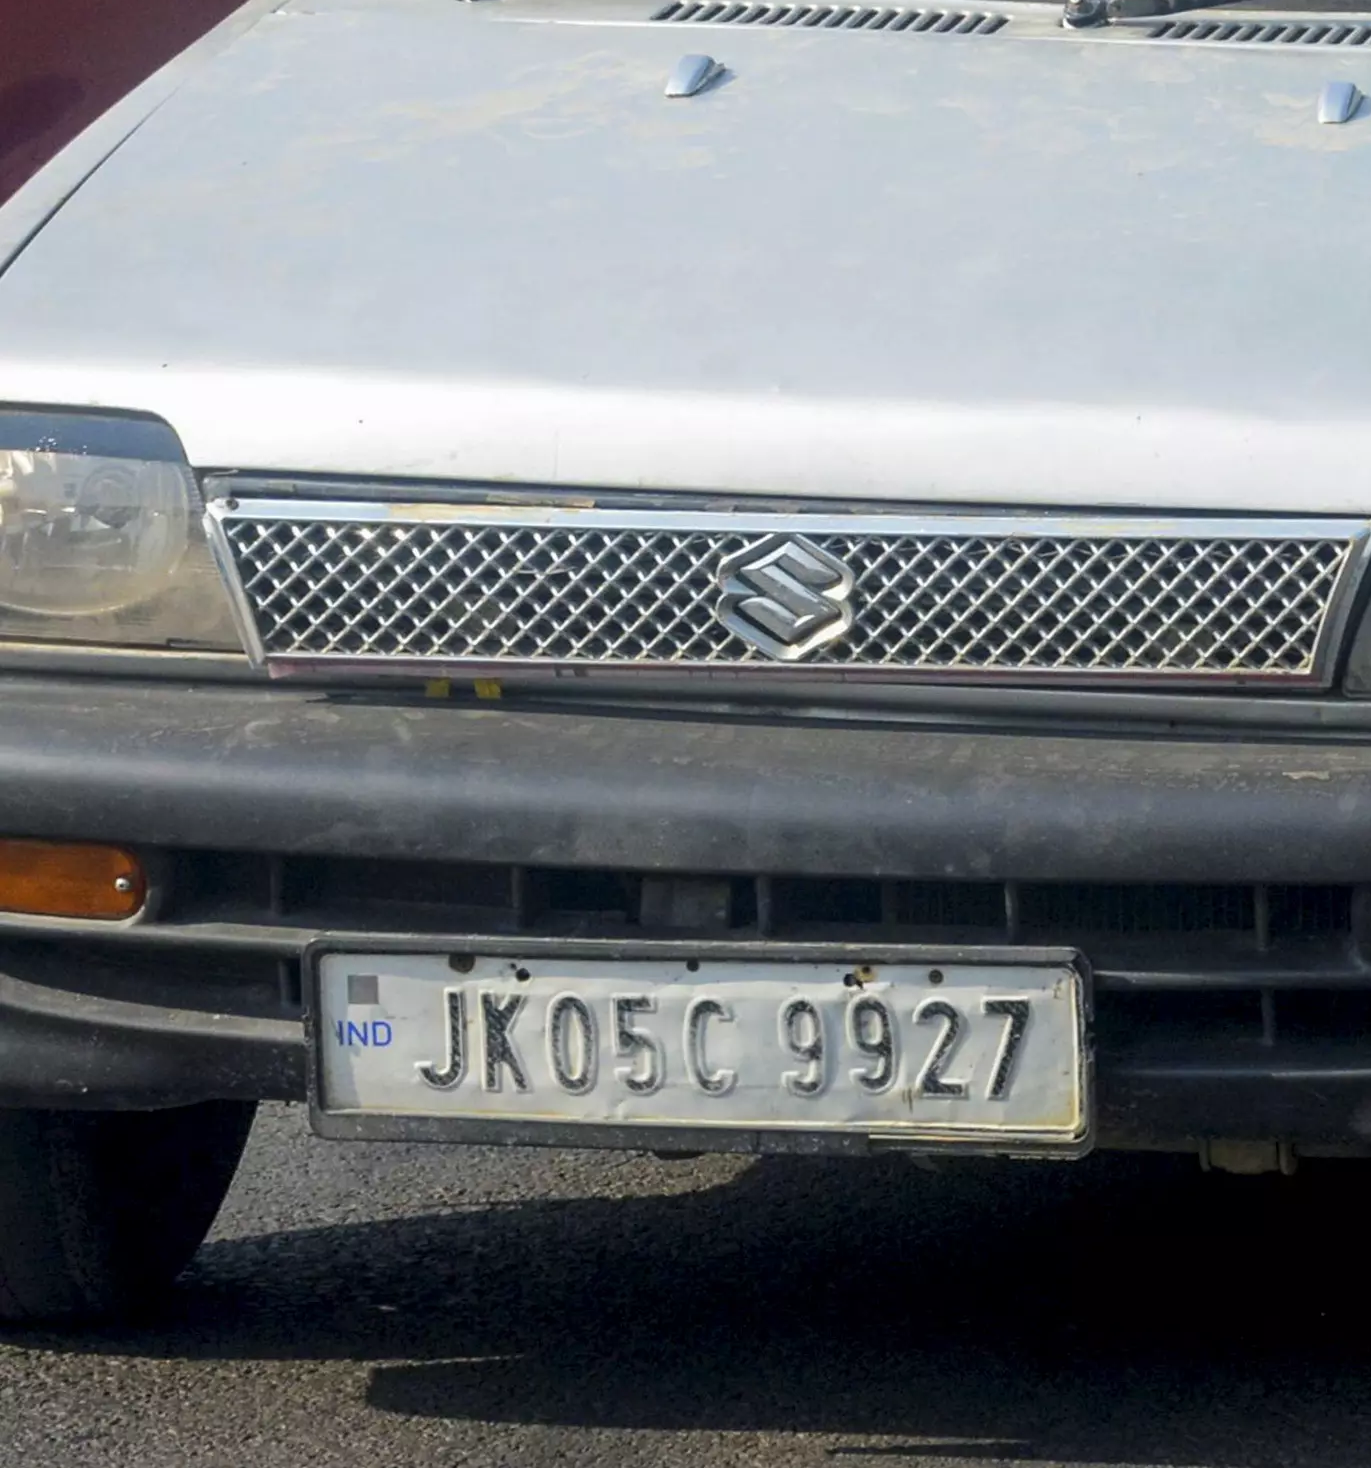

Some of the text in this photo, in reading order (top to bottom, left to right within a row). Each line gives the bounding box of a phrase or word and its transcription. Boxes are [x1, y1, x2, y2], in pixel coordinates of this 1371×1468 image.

[337, 1019, 393, 1048] IND
[413, 986, 1032, 1102] JK05C 9927
